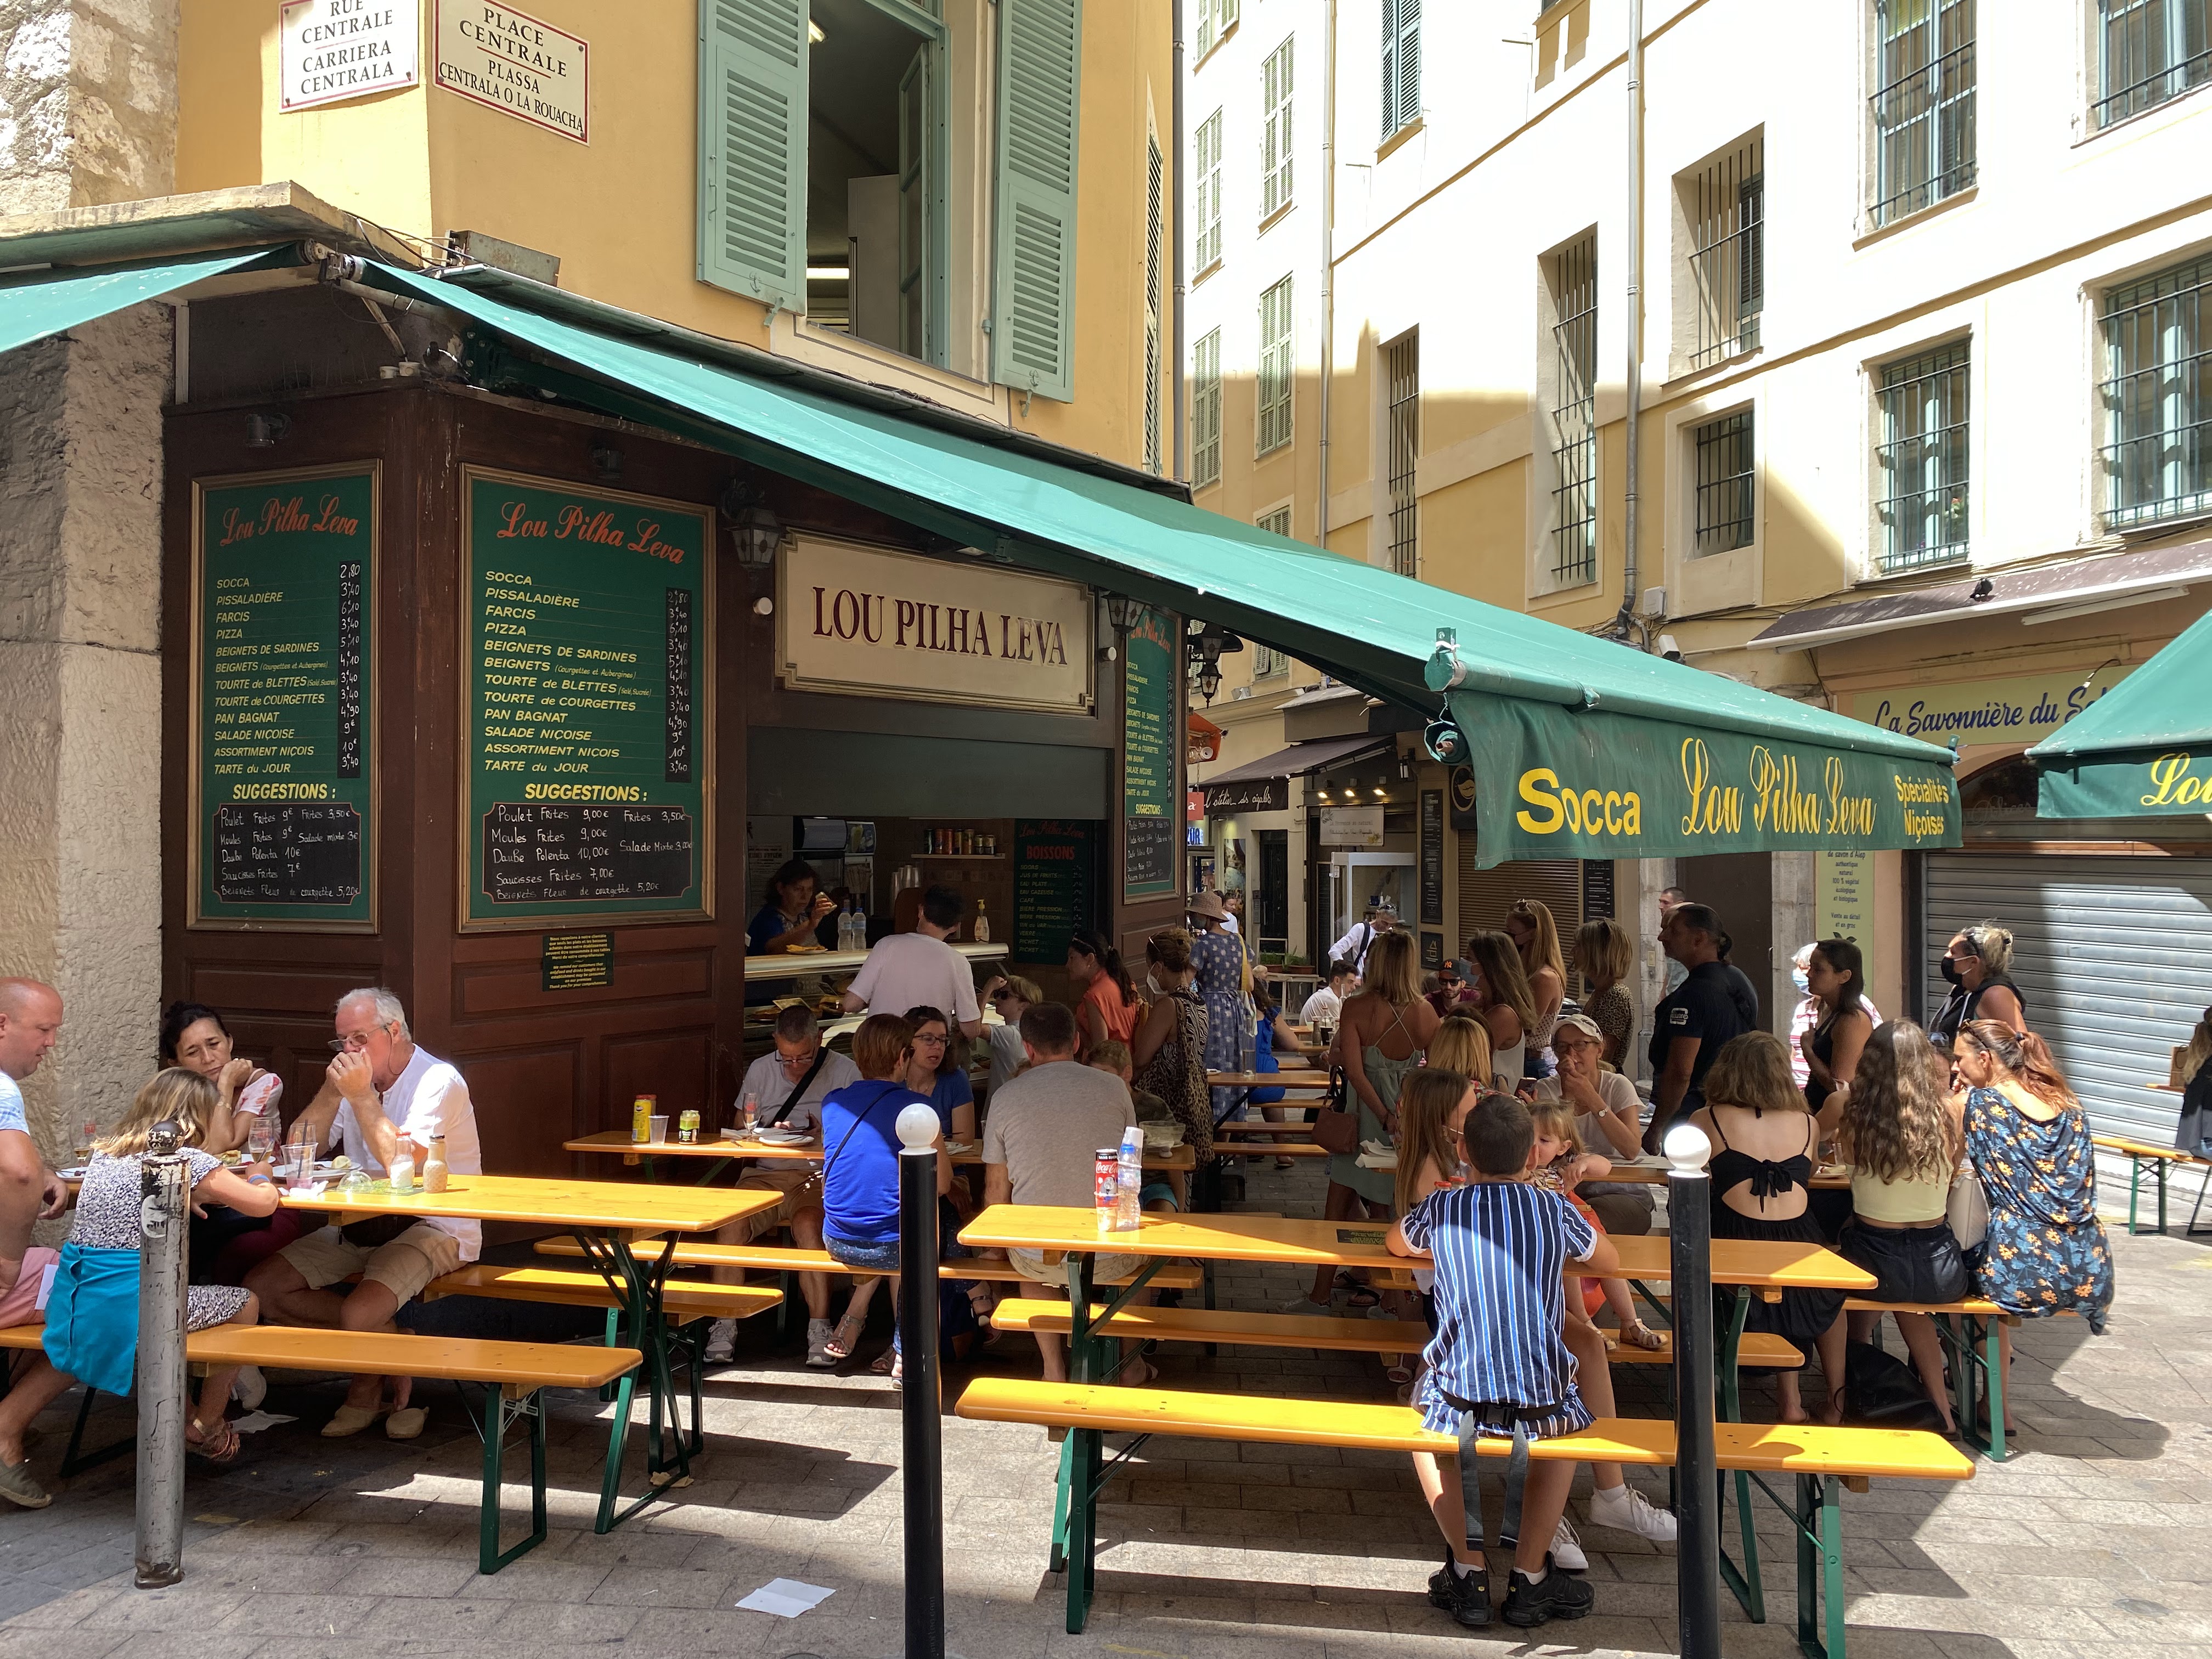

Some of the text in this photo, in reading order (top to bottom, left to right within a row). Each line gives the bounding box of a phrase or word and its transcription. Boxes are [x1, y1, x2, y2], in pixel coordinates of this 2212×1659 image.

[330, 0, 364, 17] RUE
[302, 9, 393, 44] CENTRALE
[484, 7, 544, 47] PLACE
[303, 40, 392, 72] CARRIERA
[460, 20, 567, 78] CENTRALE
[301, 61, 394, 94] CENTRALA
[488, 59, 540, 94] PLASSA
[439, 61, 584, 133] CENTRALA O LA ROUACHA
[220, 494, 359, 546] Lou Pilha Leva
[496, 501, 685, 565] Lou Pilha Leva
[217, 578, 250, 589] SOCCA
[486, 571, 532, 585] SOCCA
[217, 592, 283, 606] PISSALADIÈRE
[486, 588, 580, 608] PISSALADIÈRE
[216, 612, 250, 623] FARCIS
[486, 605, 536, 619] FARCIS
[216, 629, 242, 640] PIZZA
[484, 623, 526, 636] PIZZA
[812, 586, 1068, 666] LOU PILHA LEVA
[216, 642, 319, 657] BEIGNETS DE SARDINES
[484, 640, 637, 663] BEIGNETS DE SARDINES
[216, 662, 258, 673] BEIGNETS
[484, 657, 550, 672] BEIGNETS
[216, 676, 307, 690] TOURTE de BLETTES
[484, 674, 537, 687] TOURTE
[543, 680, 557, 689] de
[562, 680, 617, 693] BLETTES
[215, 694, 325, 707] TOURTE de COURGETTES
[484, 692, 636, 711] TOURTE de COURGETTES
[215, 712, 280, 724] PAN BAGNAT
[484, 708, 568, 723] PAN BAGNAT
[1875, 701, 1901, 733] La
[1906, 701, 2024, 737] Savonnière
[2029, 692, 2059, 725] du
[215, 729, 295, 741] SALADE NIÇOISE
[484, 726, 592, 741] SALADE NIÇOISE
[215, 746, 314, 757] ASSORTIMENT NIÇOIS
[484, 743, 620, 758] ASSORTIMENT NIÇOIS
[215, 764, 291, 774] TARTE du JOUR
[484, 760, 589, 773] TARTE du JOUR
[233, 783, 327, 800] SUGGESTIONS
[525, 783, 640, 801] SUGGESTIONS
[1681, 737, 1877, 836] Lou Pilha Leva
[1895, 774, 1949, 805] Spécialités
[1238, 792, 1249, 804] des
[1252, 786, 1272, 811] cigales
[1516, 768, 1641, 836] Socca
[498, 805, 533, 822] Poulet
[583, 810, 609, 820] 9,00€
[662, 811, 685, 823] 3,50€
[1136, 803, 1161, 815] SUGGESTIONS
[221, 808, 244, 828] Poulet
[1904, 809, 1944, 844] Niçoises
[492, 826, 527, 844] Moules
[580, 827, 608, 842] 9,00€
[537, 848, 569, 862] Polenta
[578, 846, 610, 861] 10,00€
[620, 840, 651, 853] Salade
[1026, 845, 1075, 860] BOISSONS
[1850, 851, 1865, 860] d'Alep
[496, 873, 542, 886] Saucisses
[590, 868, 614, 881] 7,00€
[580, 887, 589, 895] de
[637, 882, 659, 893] 5,20€
